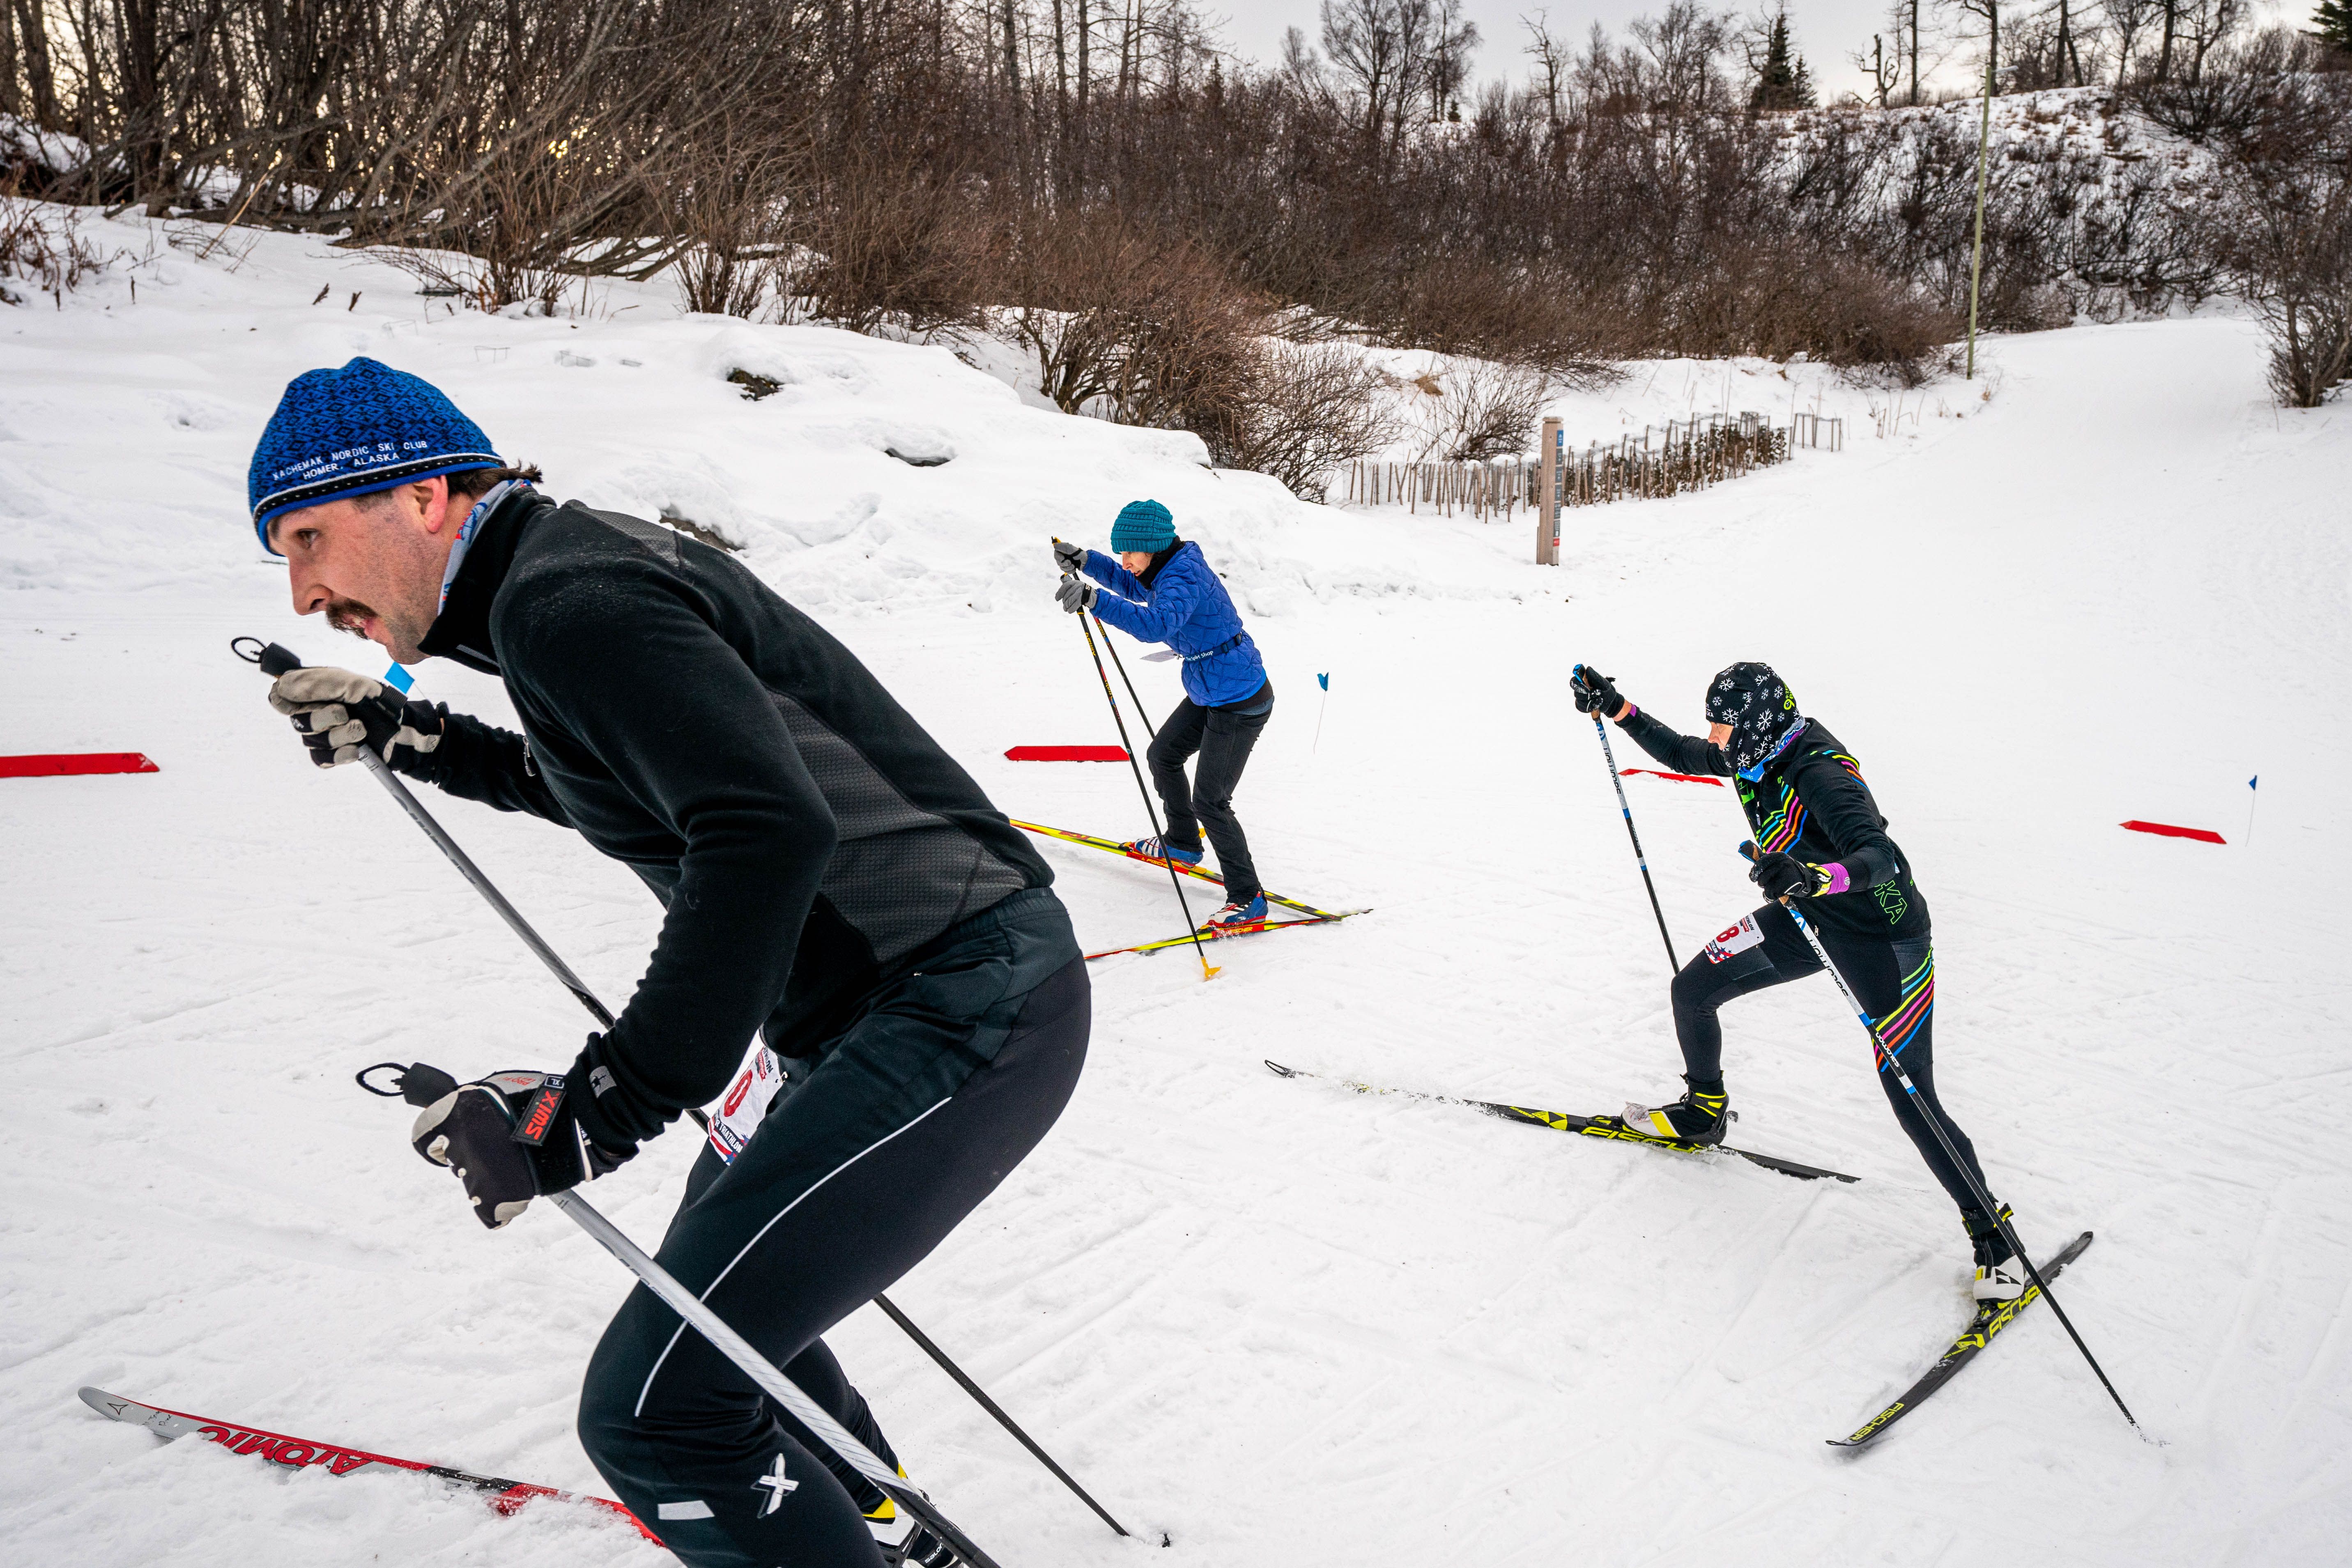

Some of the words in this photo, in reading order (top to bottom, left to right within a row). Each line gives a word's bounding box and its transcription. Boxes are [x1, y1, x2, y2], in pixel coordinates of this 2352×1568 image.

[331, 446, 370, 461] NORDIC
[378, 442, 395, 452] SKI
[403, 441, 428, 450] CLUB
[353, 452, 400, 467] ALASKA
[1201, 651, 1214, 659] Shop
[1145, 858, 1175, 869] FISCHE
[525, 1090, 556, 1140] SWIX
[719, 1122, 744, 1153] TRIATHLON
[1989, 1284, 2041, 1339] FISCHE
[1848, 1402, 1905, 1442] FISCHER
